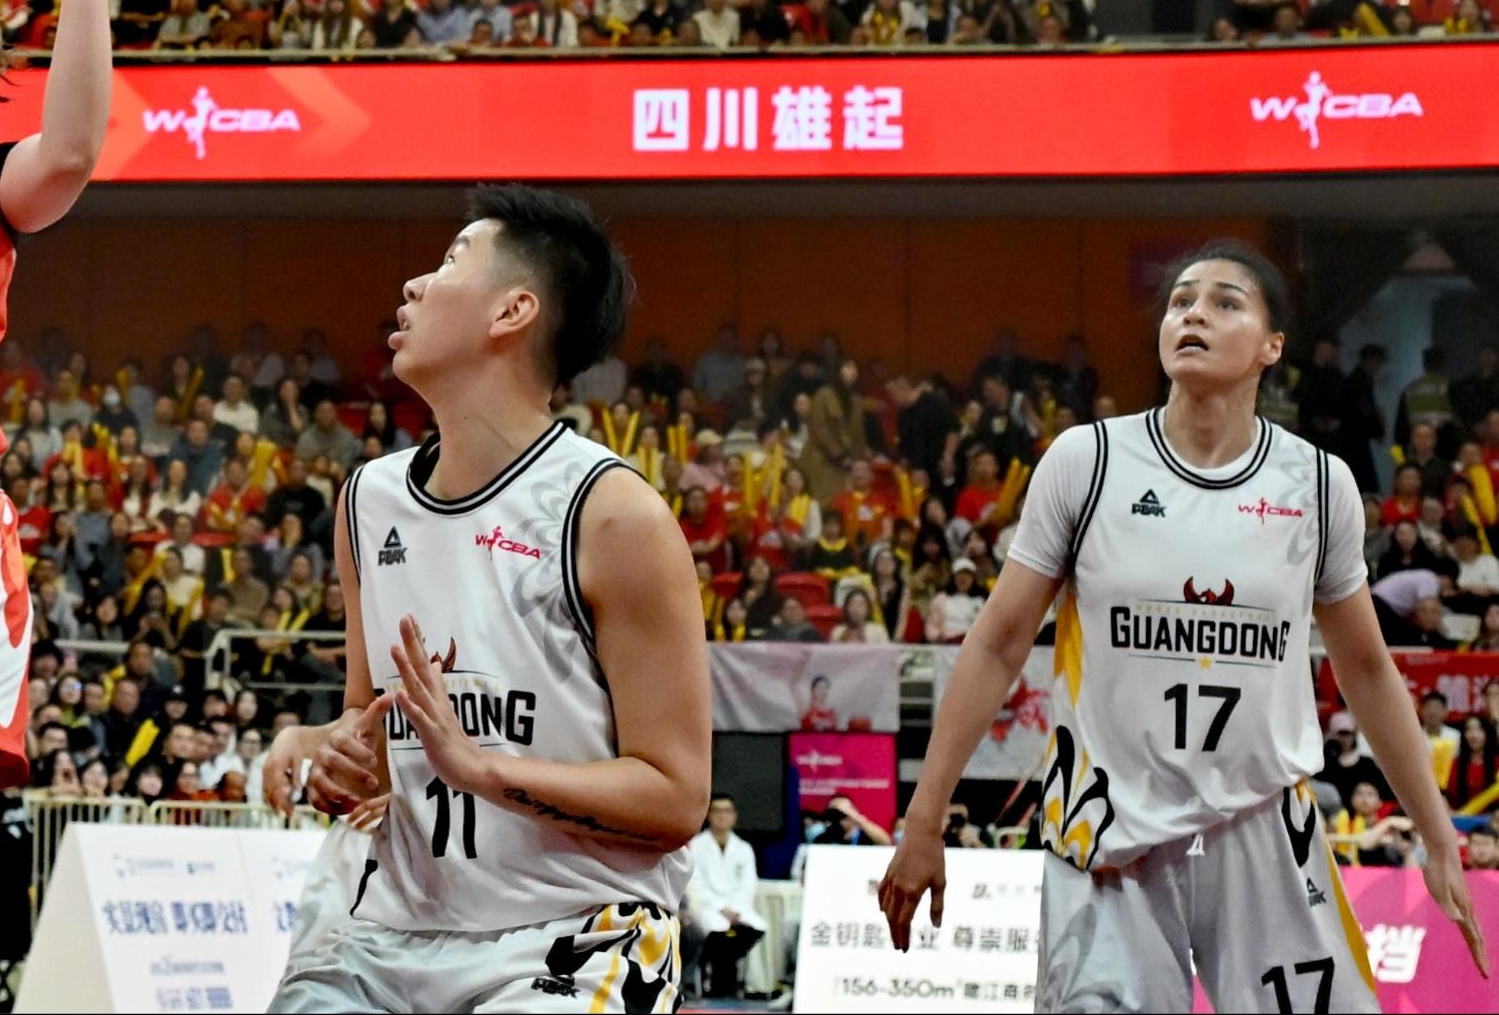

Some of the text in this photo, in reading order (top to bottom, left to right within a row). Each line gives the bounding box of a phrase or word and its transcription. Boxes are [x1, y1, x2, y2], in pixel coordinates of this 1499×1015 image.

[632, 85, 904, 152] 四川雄起
[1110, 605, 1291, 663] GUANGDONG
[1163, 682, 1242, 753] 17
[426, 774, 478, 860] 11
[811, 921, 1040, 953] 金钥匙业 尊崇服
[1261, 956, 1336, 1014] 17
